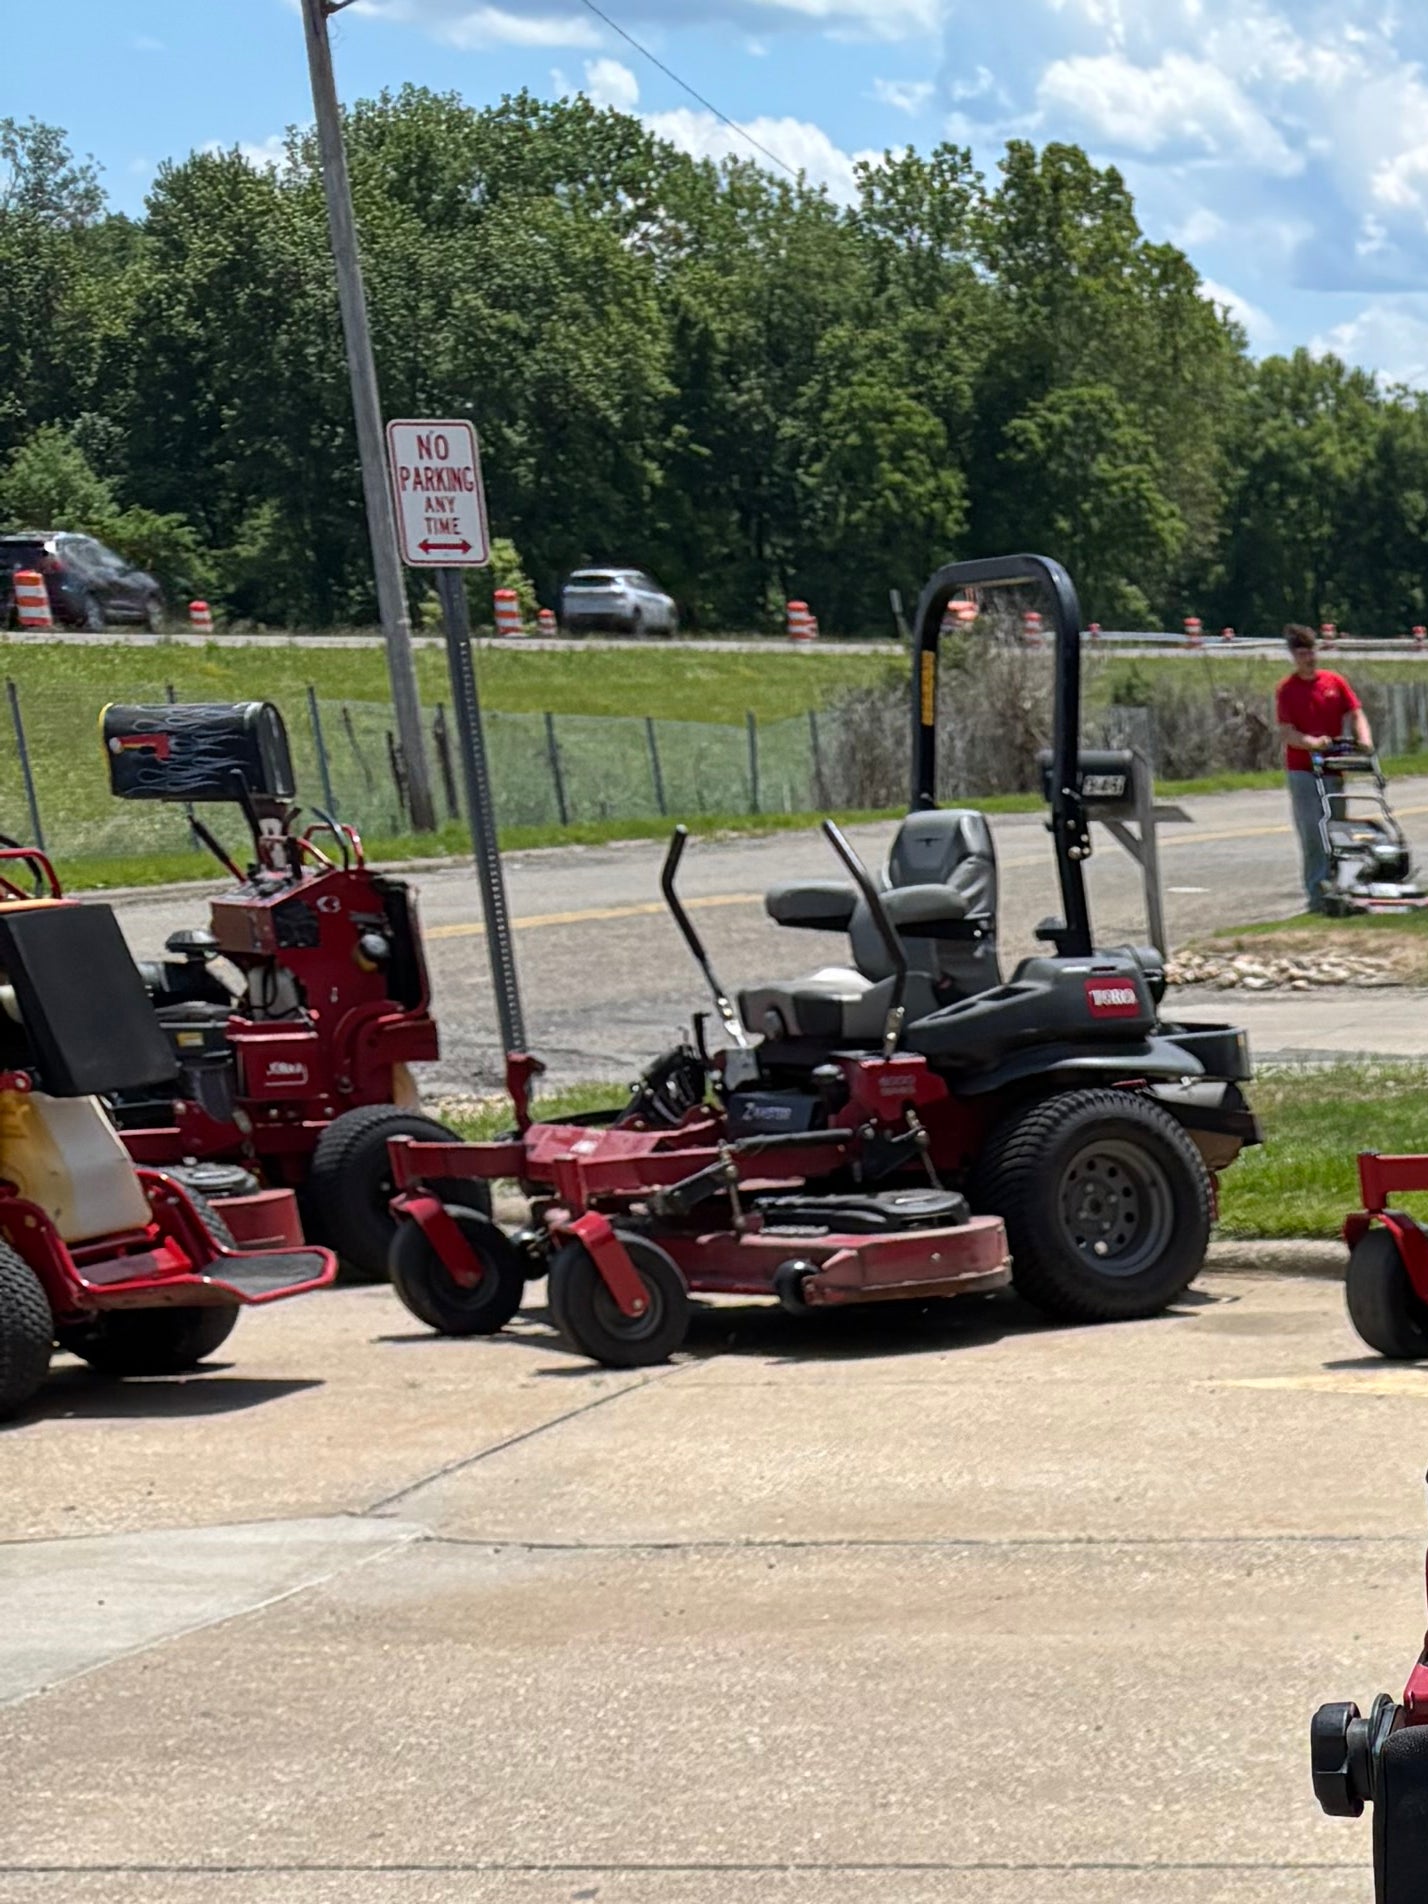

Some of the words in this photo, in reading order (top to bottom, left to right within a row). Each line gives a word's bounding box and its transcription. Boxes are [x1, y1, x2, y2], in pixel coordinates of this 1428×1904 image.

[416, 434, 449, 460] NO
[400, 466, 474, 492] PARKING
[424, 496, 456, 513] ANY
[424, 517, 462, 535] TIME
